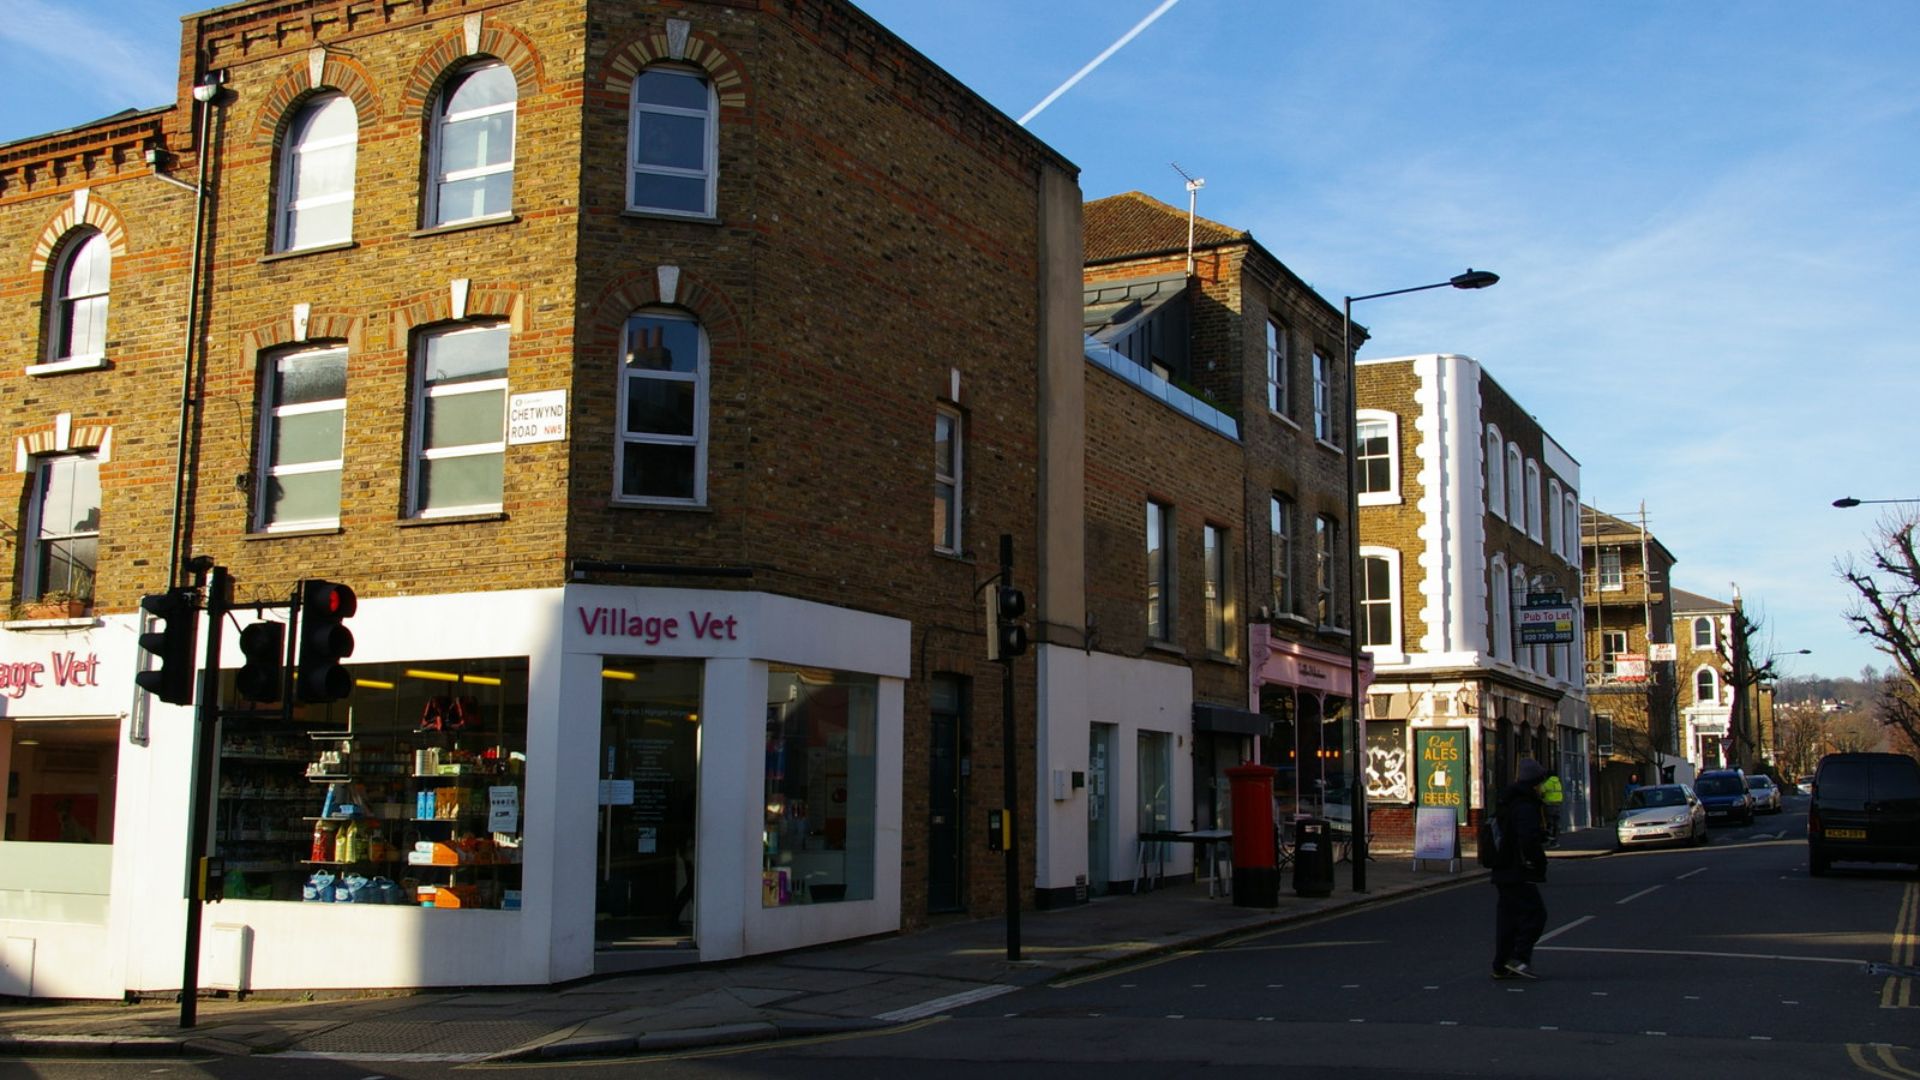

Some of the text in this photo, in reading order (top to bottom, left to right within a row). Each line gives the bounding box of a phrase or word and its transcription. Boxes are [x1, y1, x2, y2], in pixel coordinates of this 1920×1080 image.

[511, 404, 564, 422] CHETWYND
[511, 424, 562, 438] ROAD NW5
[1523, 611, 1570, 621] Pub To Let
[578, 606, 738, 645] Village Vet
[51, 650, 101, 687] Vet
[1423, 748, 1458, 761] ALES
[1423, 793, 1460, 805] BEERS
